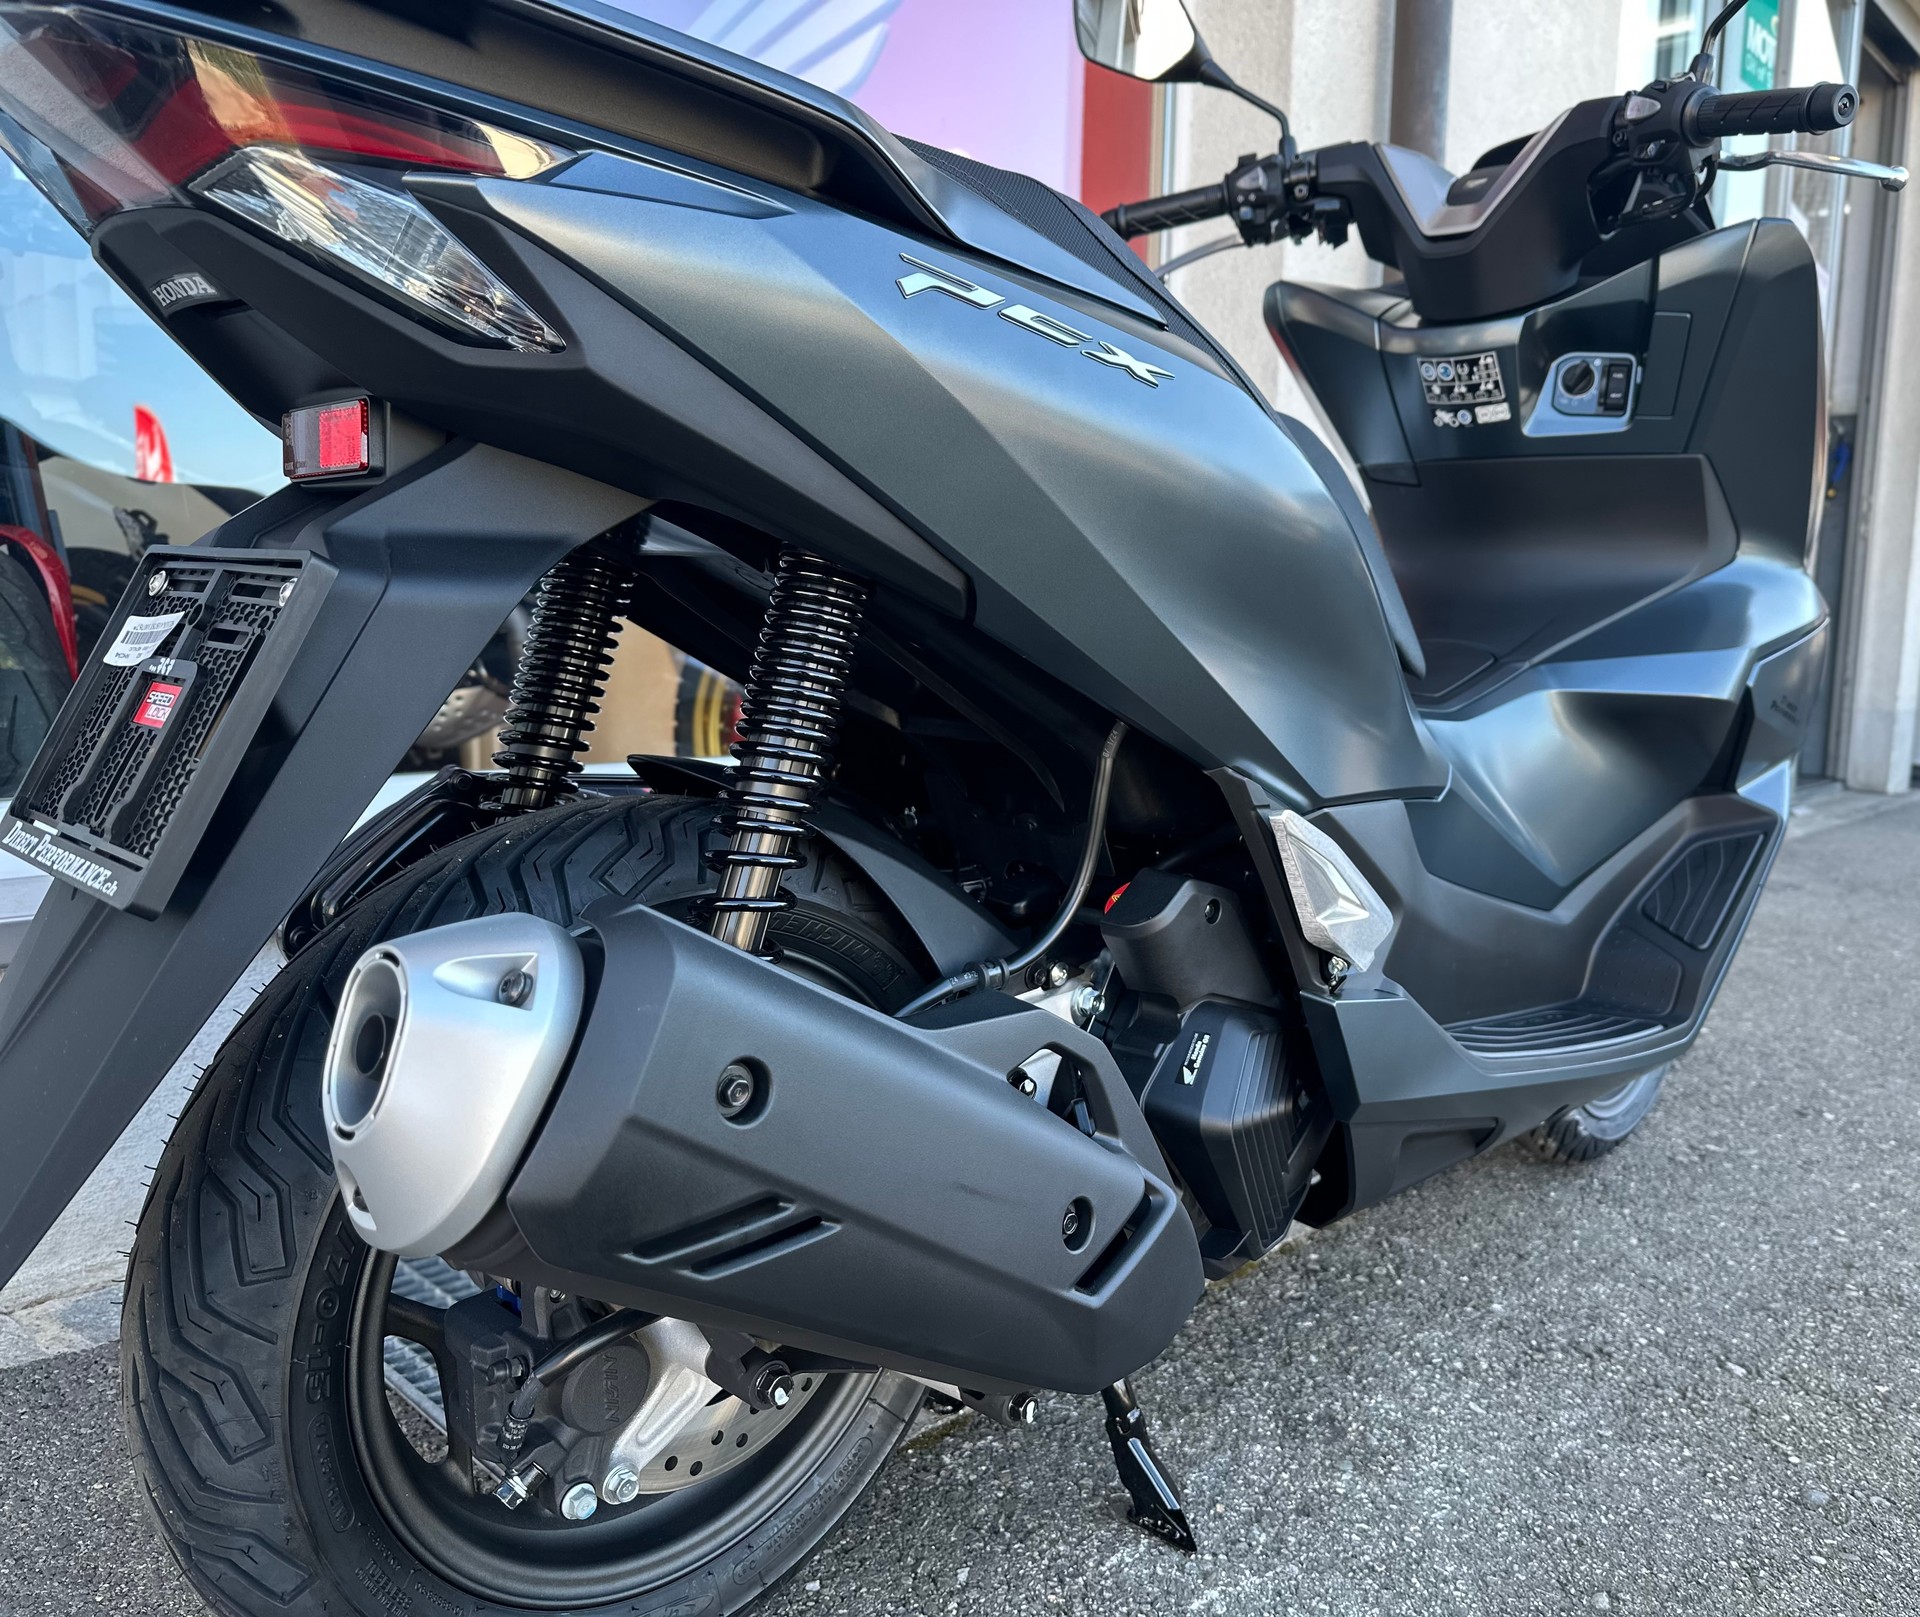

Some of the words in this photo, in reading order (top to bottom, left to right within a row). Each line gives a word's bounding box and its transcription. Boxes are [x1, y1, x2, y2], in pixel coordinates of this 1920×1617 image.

[1747, 16, 1778, 71] MOT
[152, 276, 217, 307] HONDA
[896, 252, 1176, 389] PCX
[146, 691, 175, 706] SPEED
[147, 704, 170, 719] LOCK
[2, 820, 39, 855] DIRECT
[29, 834, 118, 897] PERFORMANCE.ch
[602, 1353, 620, 1423] NISSIN
